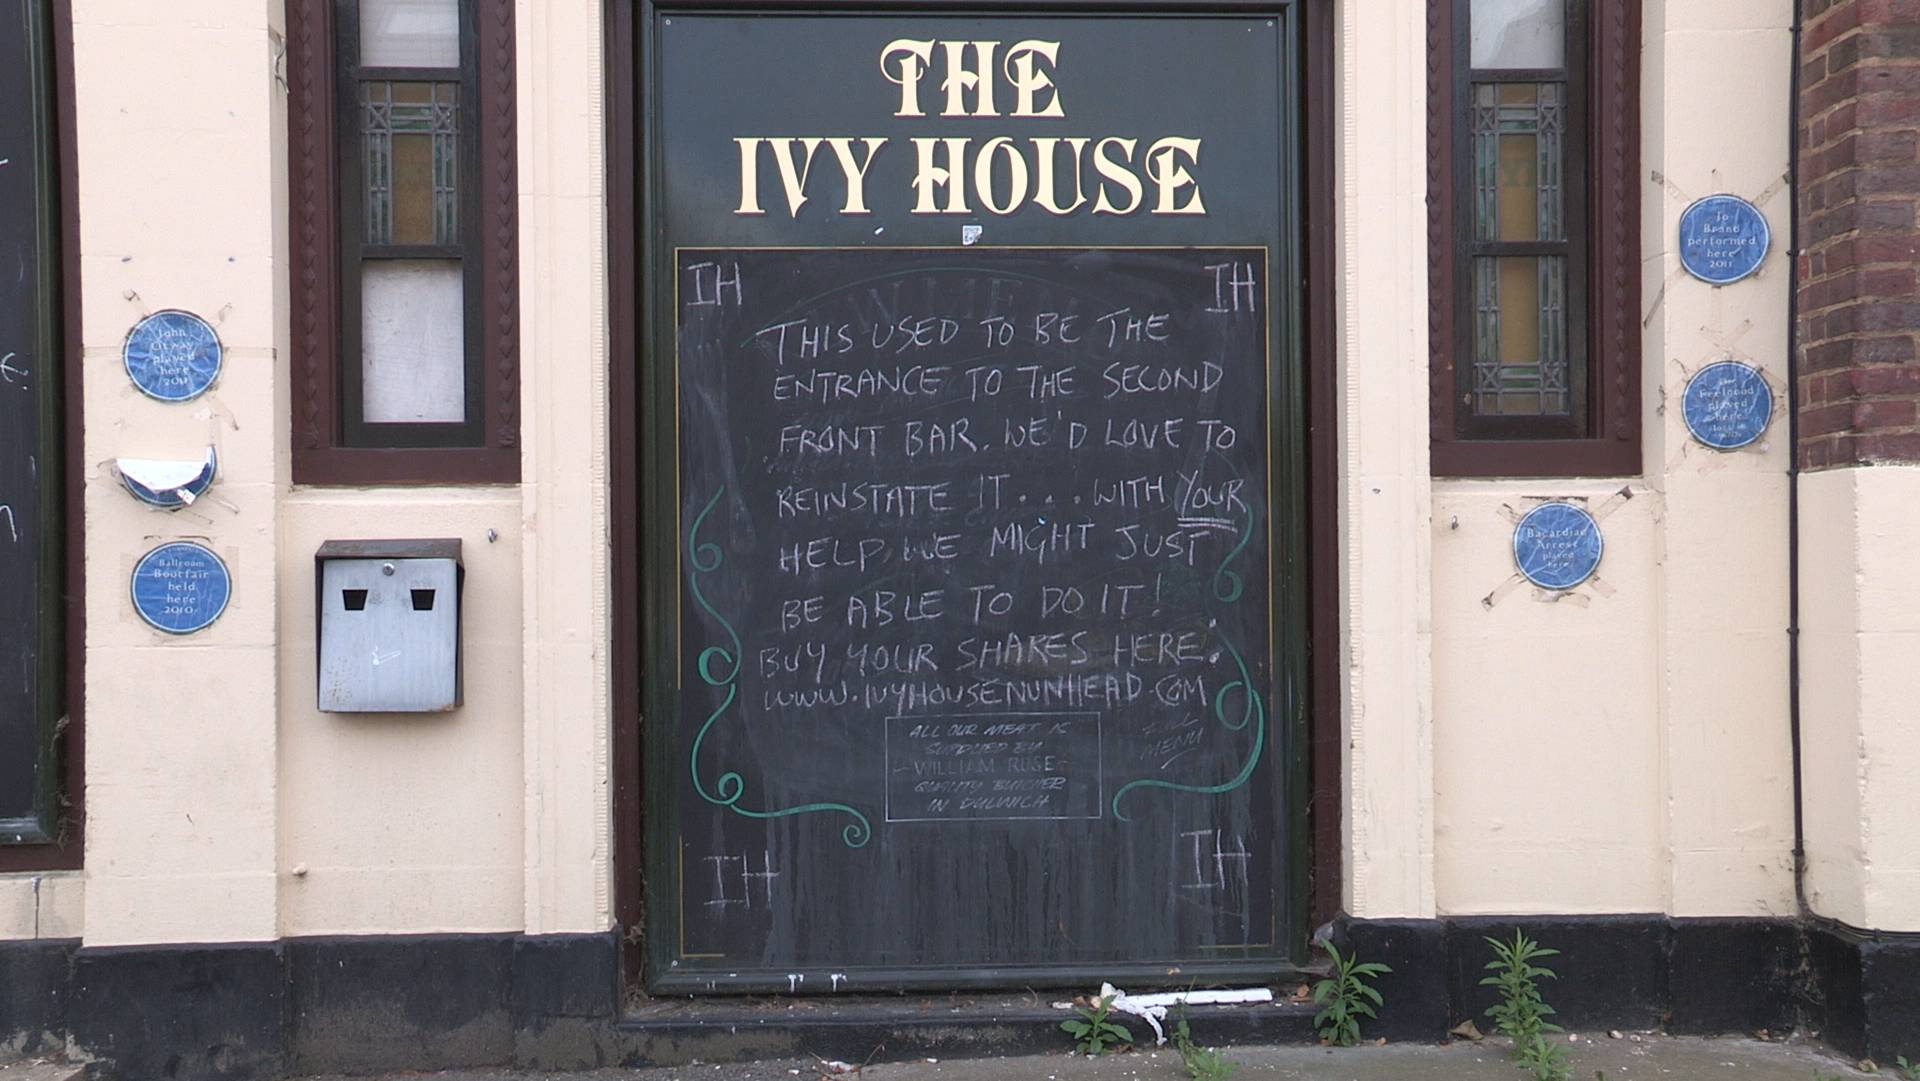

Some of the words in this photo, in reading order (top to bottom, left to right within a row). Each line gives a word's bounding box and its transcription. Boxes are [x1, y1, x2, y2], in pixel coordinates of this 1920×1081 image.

[880, 38, 1065, 118] THE
[733, 137, 889, 219] IVY
[910, 136, 1207, 216] HOUSE
[1703, 223, 1740, 233] Brand
[1687, 236, 1756, 247] performed
[1706, 249, 1735, 258] here
[688, 262, 742, 306] IH
[1204, 262, 1256, 312] IH
[756, 319, 854, 365] THIS
[872, 315, 959, 354] USED
[979, 316, 1015, 348] TO
[1035, 313, 1080, 344] BE
[1096, 307, 1170, 348] THE
[151, 342, 193, 352] Otway
[153, 353, 195, 367] played
[160, 366, 190, 375] here
[164, 377, 188, 385] 2011
[773, 366, 952, 404] ENTRANCE
[965, 366, 1001, 402] TO
[1017, 365, 1076, 400] THE
[1103, 361, 1224, 399] SECOND
[780, 425, 885, 456] FRONT
[906, 418, 990, 456] BAR.
[1004, 411, 1087, 449] WE'D
[1105, 418, 1184, 448] LOVE
[1197, 419, 1236, 452] TO
[776, 482, 954, 518] REINSTATE
[1094, 476, 1165, 508] WITH
[1175, 469, 1248, 520] YOUR
[904, 533, 962, 561] WE
[990, 522, 1096, 565] MIGHT
[1115, 524, 1210, 566] JUST
[158, 558, 205, 568] Ballroom
[168, 582, 196, 592] held
[166, 594, 196, 604] here
[782, 596, 825, 632] BE
[847, 588, 945, 628] ABLE
[969, 584, 1014, 625] TO
[1041, 586, 1085, 618] DO
[163, 606, 194, 615] 2010
[759, 641, 826, 684] BUY
[847, 642, 938, 677] YOUR
[956, 630, 1089, 672] SHARES
[909, 725, 941, 738] ALL
[948, 724, 978, 737] OUR
[983, 722, 1042, 736] MEAT
[914, 759, 995, 776] WILLIAM
[926, 798, 949, 812] IN
[959, 794, 1050, 810] DULWICH
[1180, 828, 1252, 890] IH
[703, 849, 781, 909] IH
